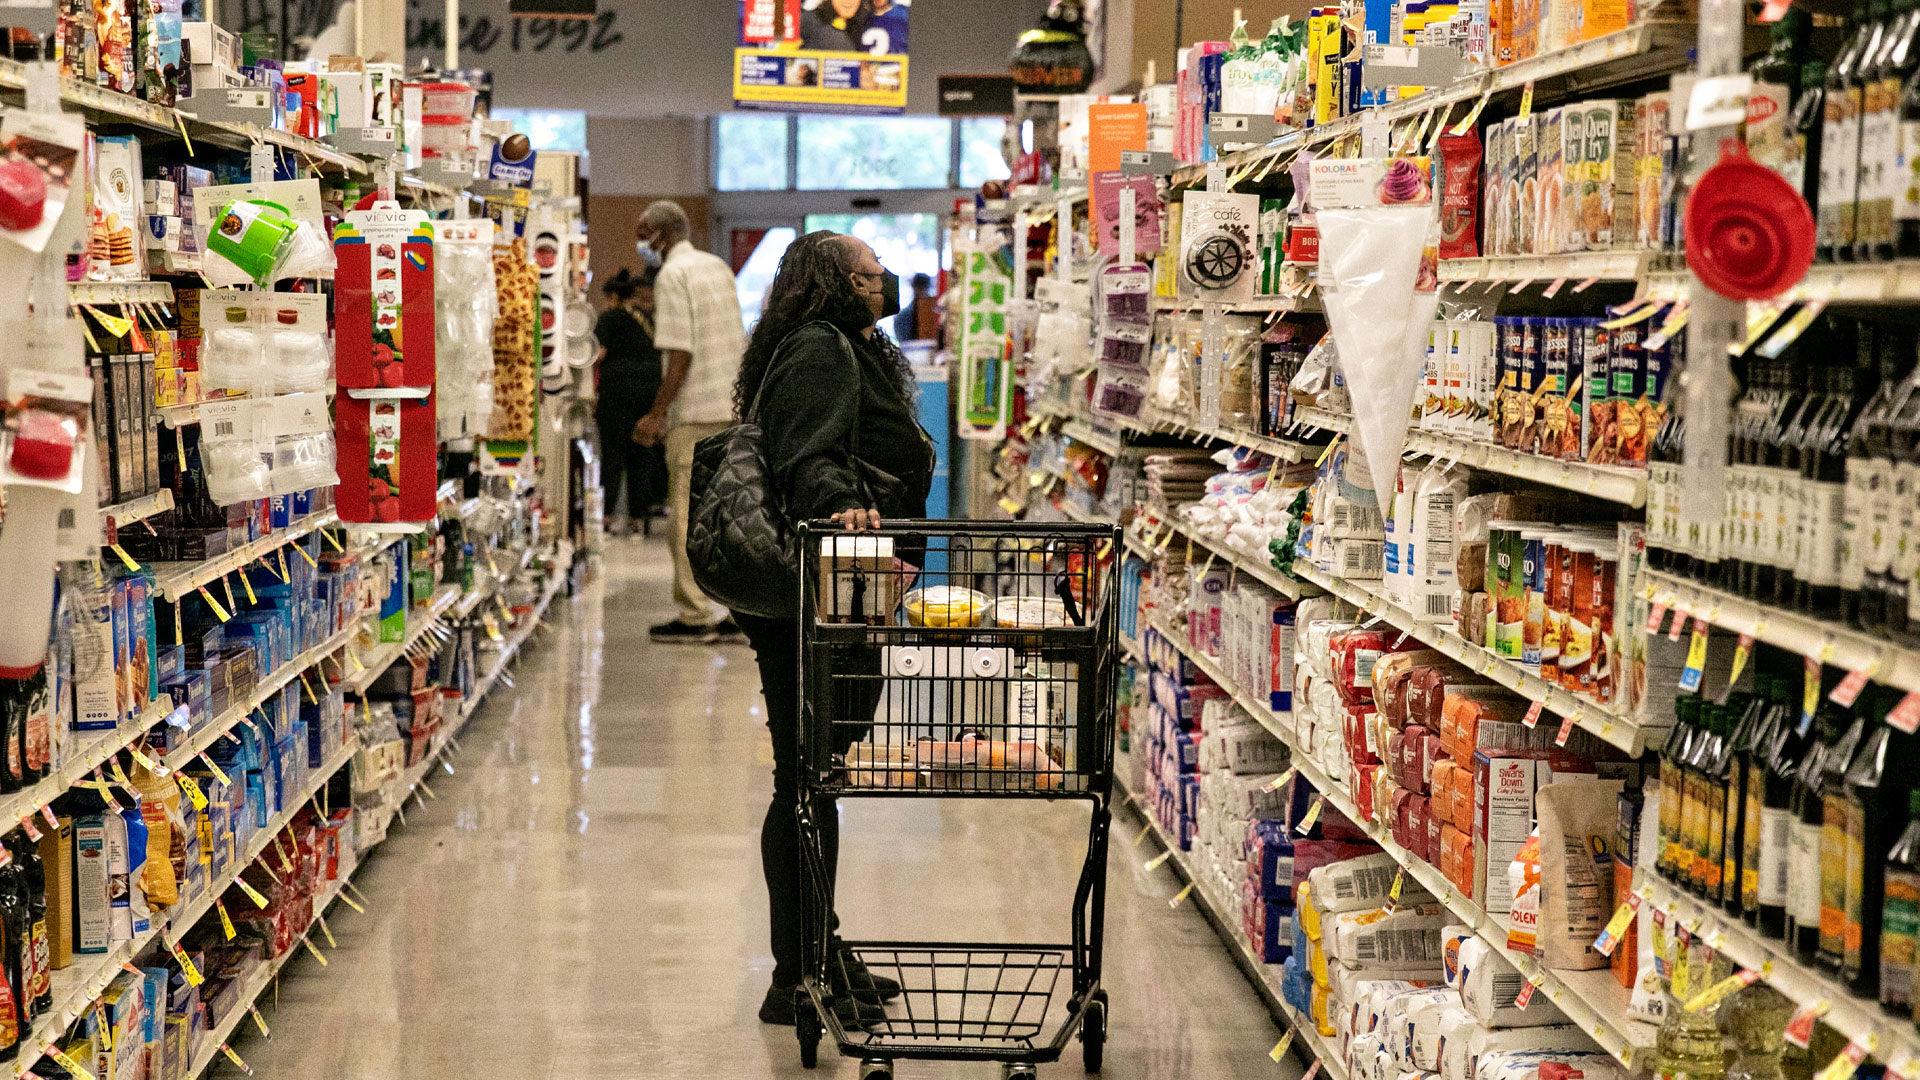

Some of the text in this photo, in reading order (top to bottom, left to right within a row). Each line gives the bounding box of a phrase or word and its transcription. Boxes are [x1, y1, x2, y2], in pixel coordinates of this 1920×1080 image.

[510, 10, 625, 52] 1992
[1314, 164, 1358, 174] KOLORAE
[1448, 183, 1463, 194] NUT
[1443, 194, 1469, 206] OATINGS
[1213, 206, 1242, 221] café
[1498, 768, 1525, 778] Swans
[1500, 777, 1524, 788] Down
[1446, 947, 1459, 959] GOL
